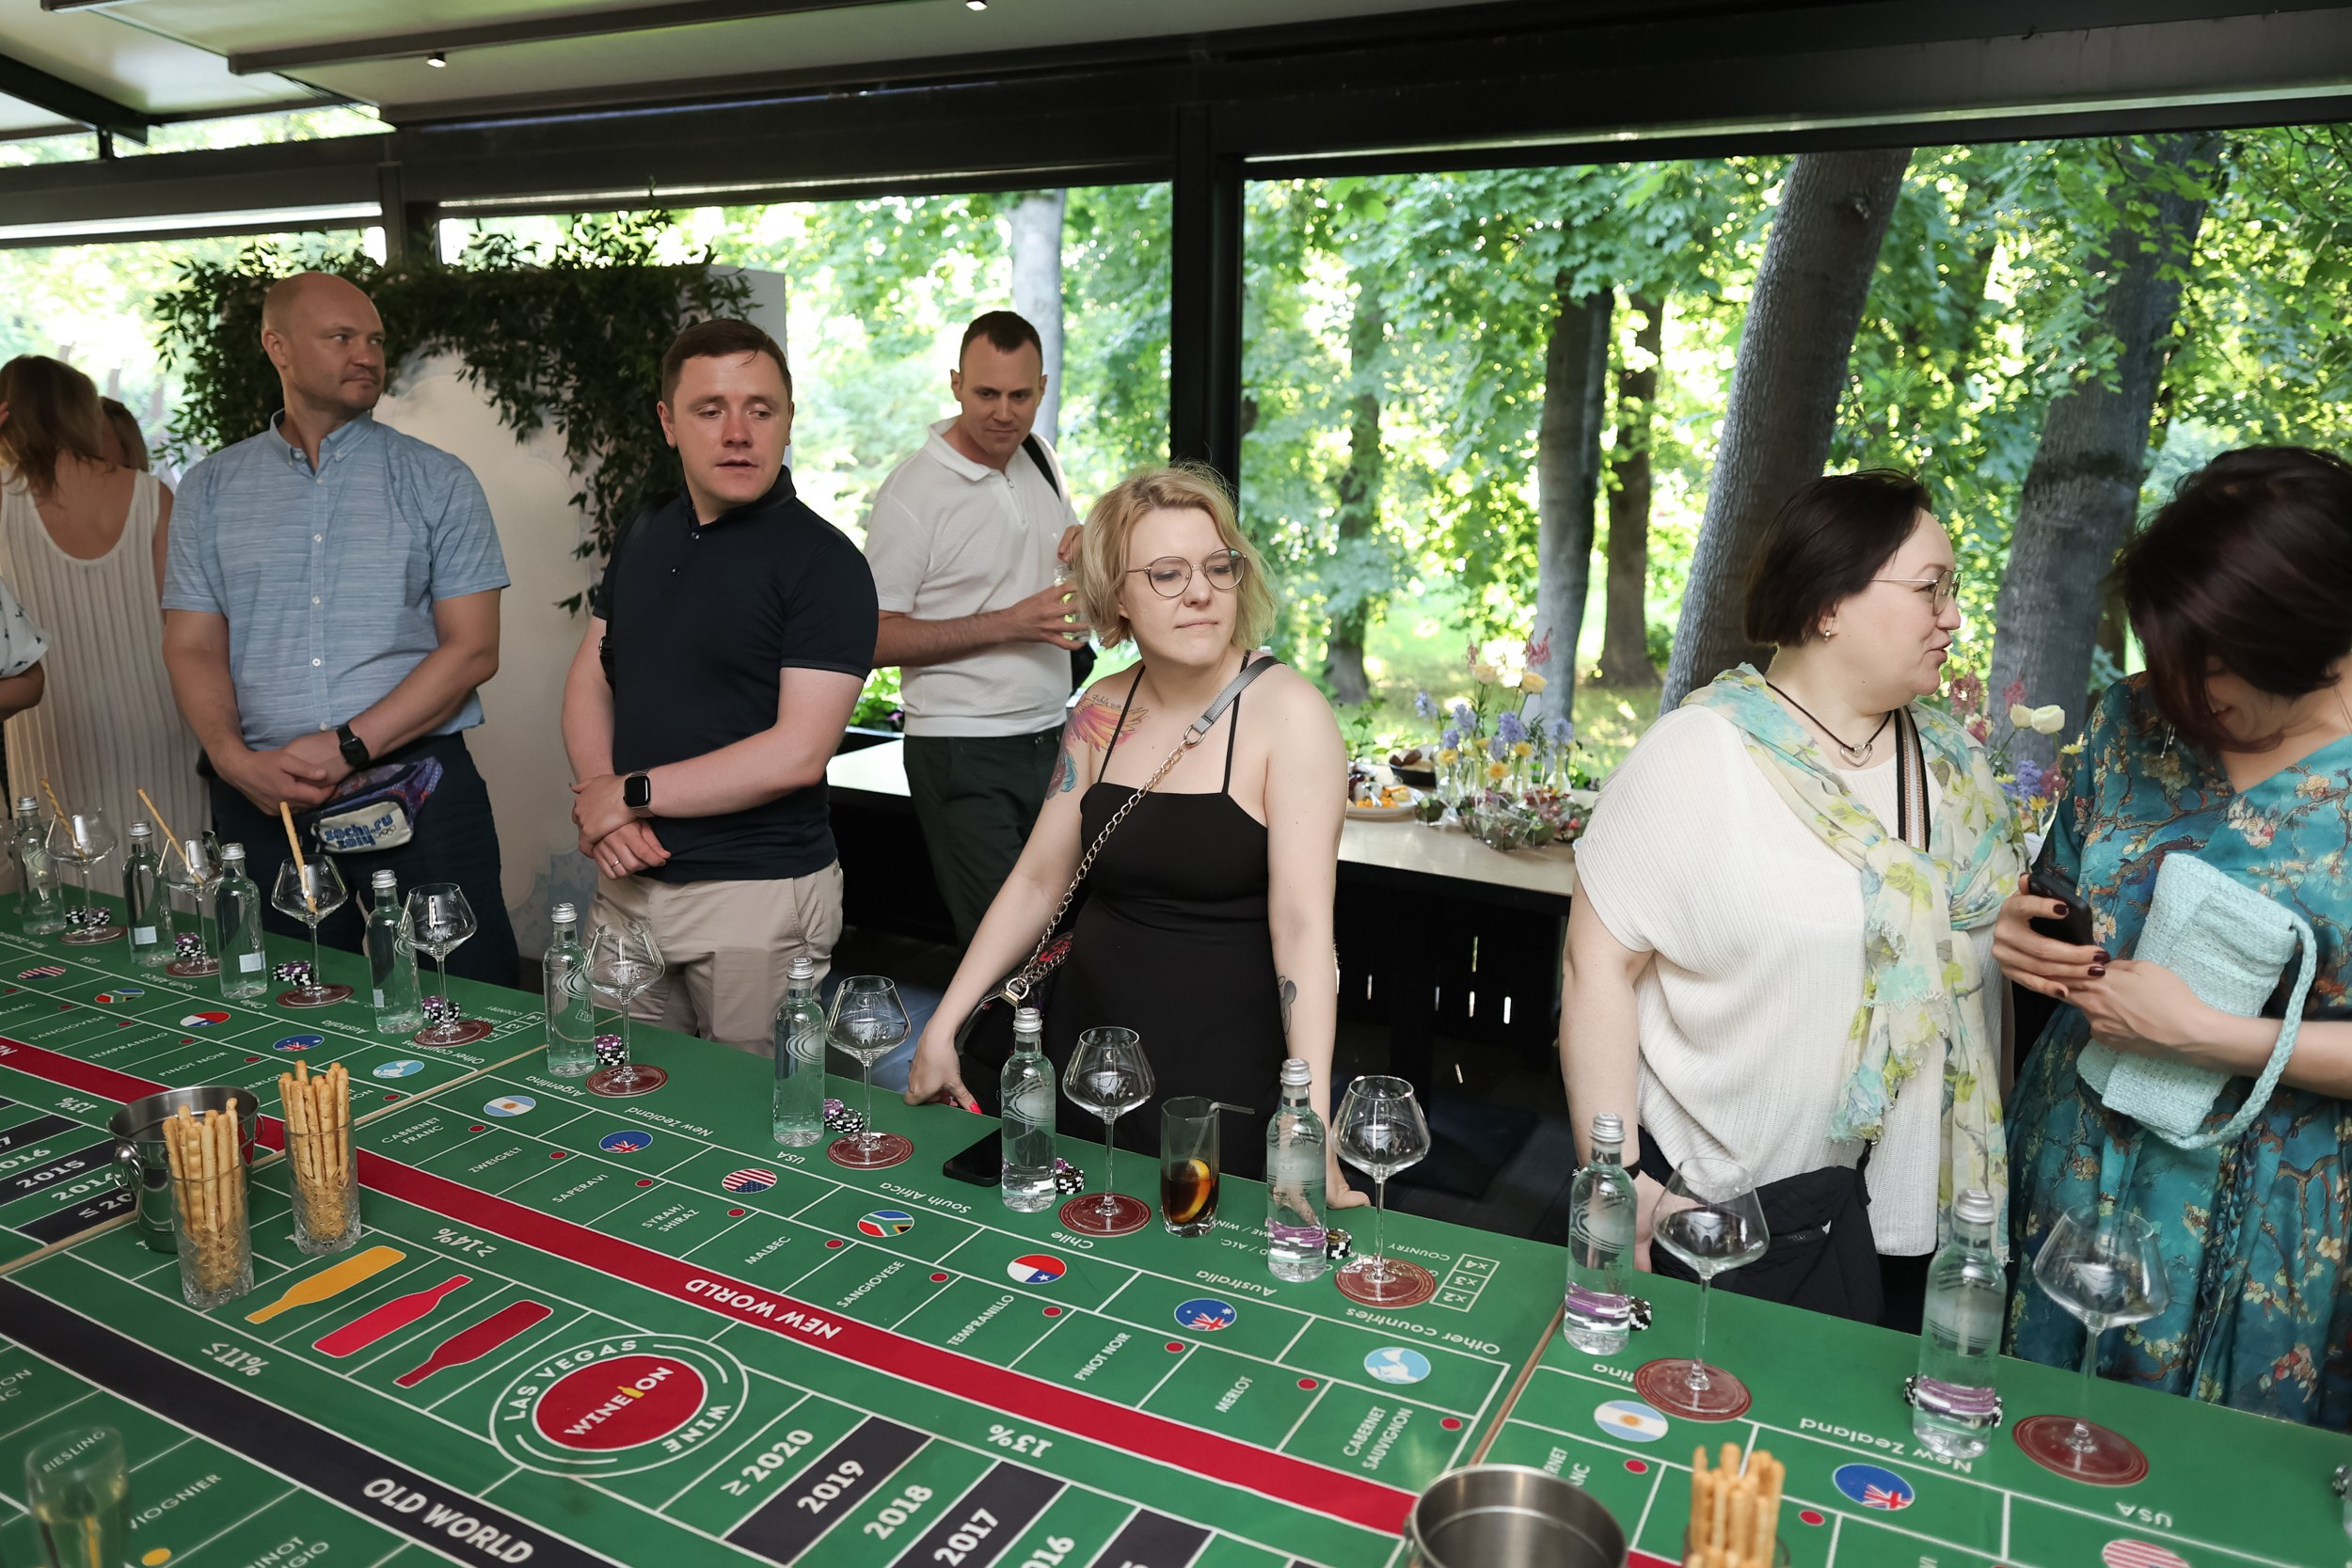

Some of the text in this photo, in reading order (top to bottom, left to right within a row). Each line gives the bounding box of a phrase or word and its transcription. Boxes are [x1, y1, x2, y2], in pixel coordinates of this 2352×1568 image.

[240, 999, 267, 1010] Chile
[29, 1015, 107, 1041] SANGIOVESE
[321, 1020, 369, 1035] Australia
[87, 1032, 168, 1060] TEMPRANILLO
[455, 1050, 485, 1065] Other
[158, 1051, 229, 1077] PINOT NOIR
[525, 1074, 587, 1099] Argentina
[55, 1097, 99, 1115] 13%
[380, 1116, 441, 1145] CABERNET
[402, 1125, 445, 1146] FRANC
[625, 1106, 715, 1137] New Zealand
[468, 1147, 523, 1173] ZWEIGELT
[776, 1150, 806, 1165] USA
[16, 1160, 86, 1189] 2015
[552, 1174, 609, 1204] SAPERAVI
[879, 1181, 972, 1213] South Africa
[642, 1203, 685, 1229] SYRAH/
[659, 1208, 700, 1233] SHIRAZ
[744, 1235, 792, 1266] MALBEC
[1051, 1231, 1094, 1249] Chile
[1220, 1238, 1248, 1250] ALC.
[1387, 1243, 1451, 1261] COUNTRY
[1465, 1259, 1488, 1271] x4
[836, 1260, 906, 1308] SANGIOVESE
[1196, 1269, 1278, 1298] Australia
[1454, 1275, 1478, 1287] x3
[685, 1279, 843, 1339] NEW WORLD
[1441, 1291, 1467, 1304] x2
[947, 1294, 1015, 1347] TEMPRANILLO
[1345, 1307, 1502, 1355] Other countries
[1073, 1332, 1132, 1382] PINOT NOIR
[503, 1340, 638, 1421] LAS VEGAS
[1215, 1375, 1254, 1414] MERLOT
[661, 1404, 732, 1453] WINE
[987, 1423, 1054, 1460] 13%
[1343, 1405, 1384, 1458] CABERNET
[1361, 1407, 1414, 1470] SAUVIGNON
[741, 1429, 814, 1483] 2020
[1799, 1418, 1973, 1474] New Zealand
[797, 1460, 866, 1515] 2019
[363, 1479, 534, 1563] OLD WORLD
[863, 1484, 933, 1541] 2018
[2115, 1501, 2173, 1528] USA
[933, 1507, 999, 1567] 2017
